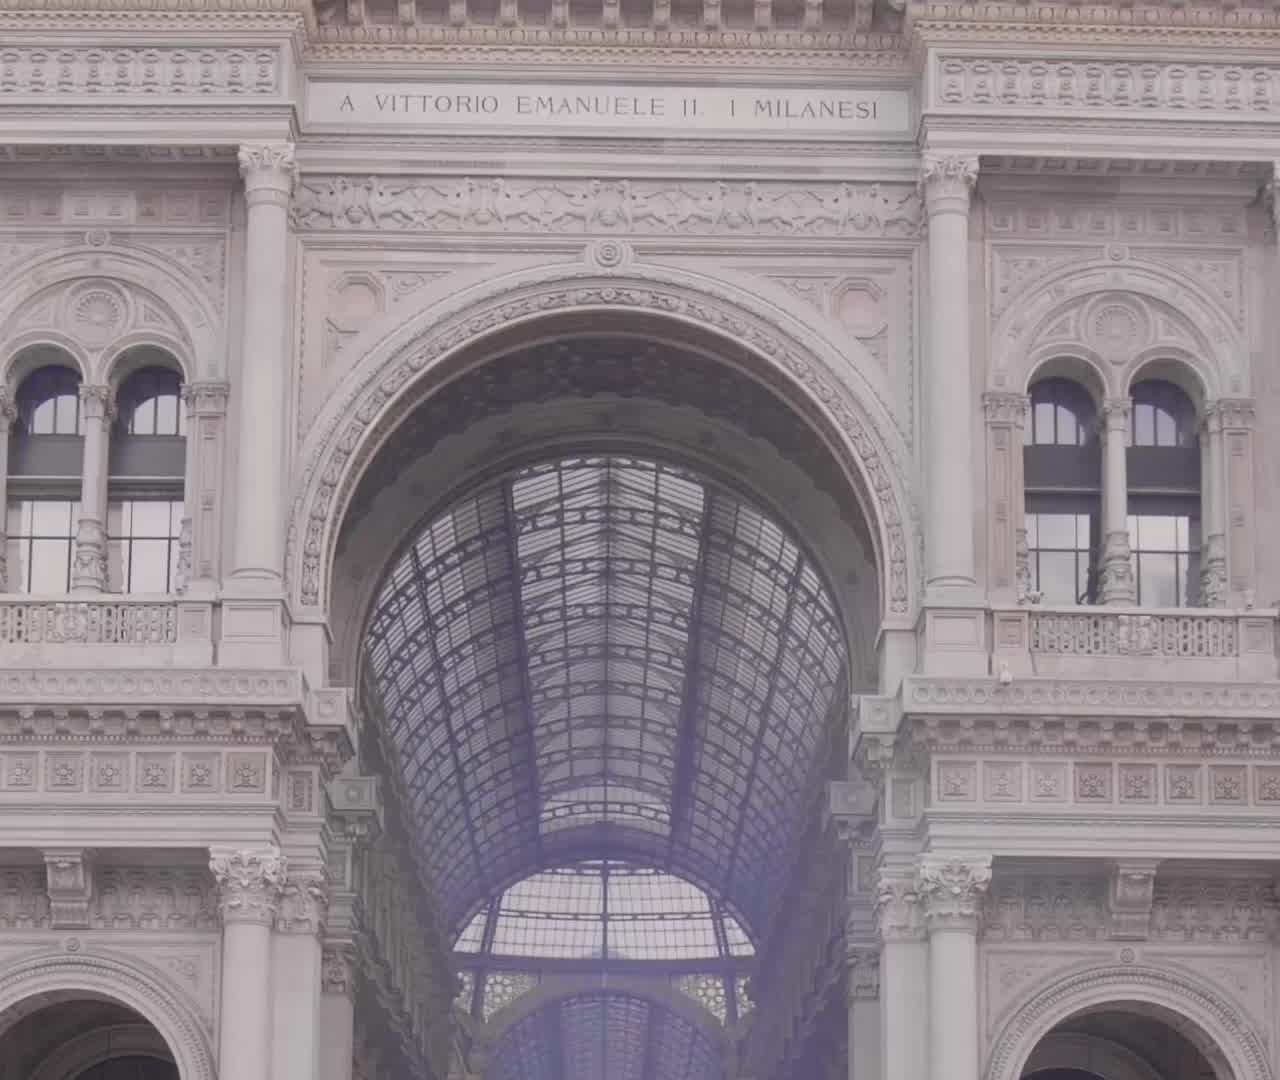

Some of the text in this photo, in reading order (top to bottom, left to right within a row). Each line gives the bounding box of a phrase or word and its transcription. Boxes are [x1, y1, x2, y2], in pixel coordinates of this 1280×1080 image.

[339, 95, 356, 112] A
[376, 95, 499, 113] VITTORIO
[517, 96, 665, 116] EMANUELE
[754, 100, 878, 119] MILANESI
